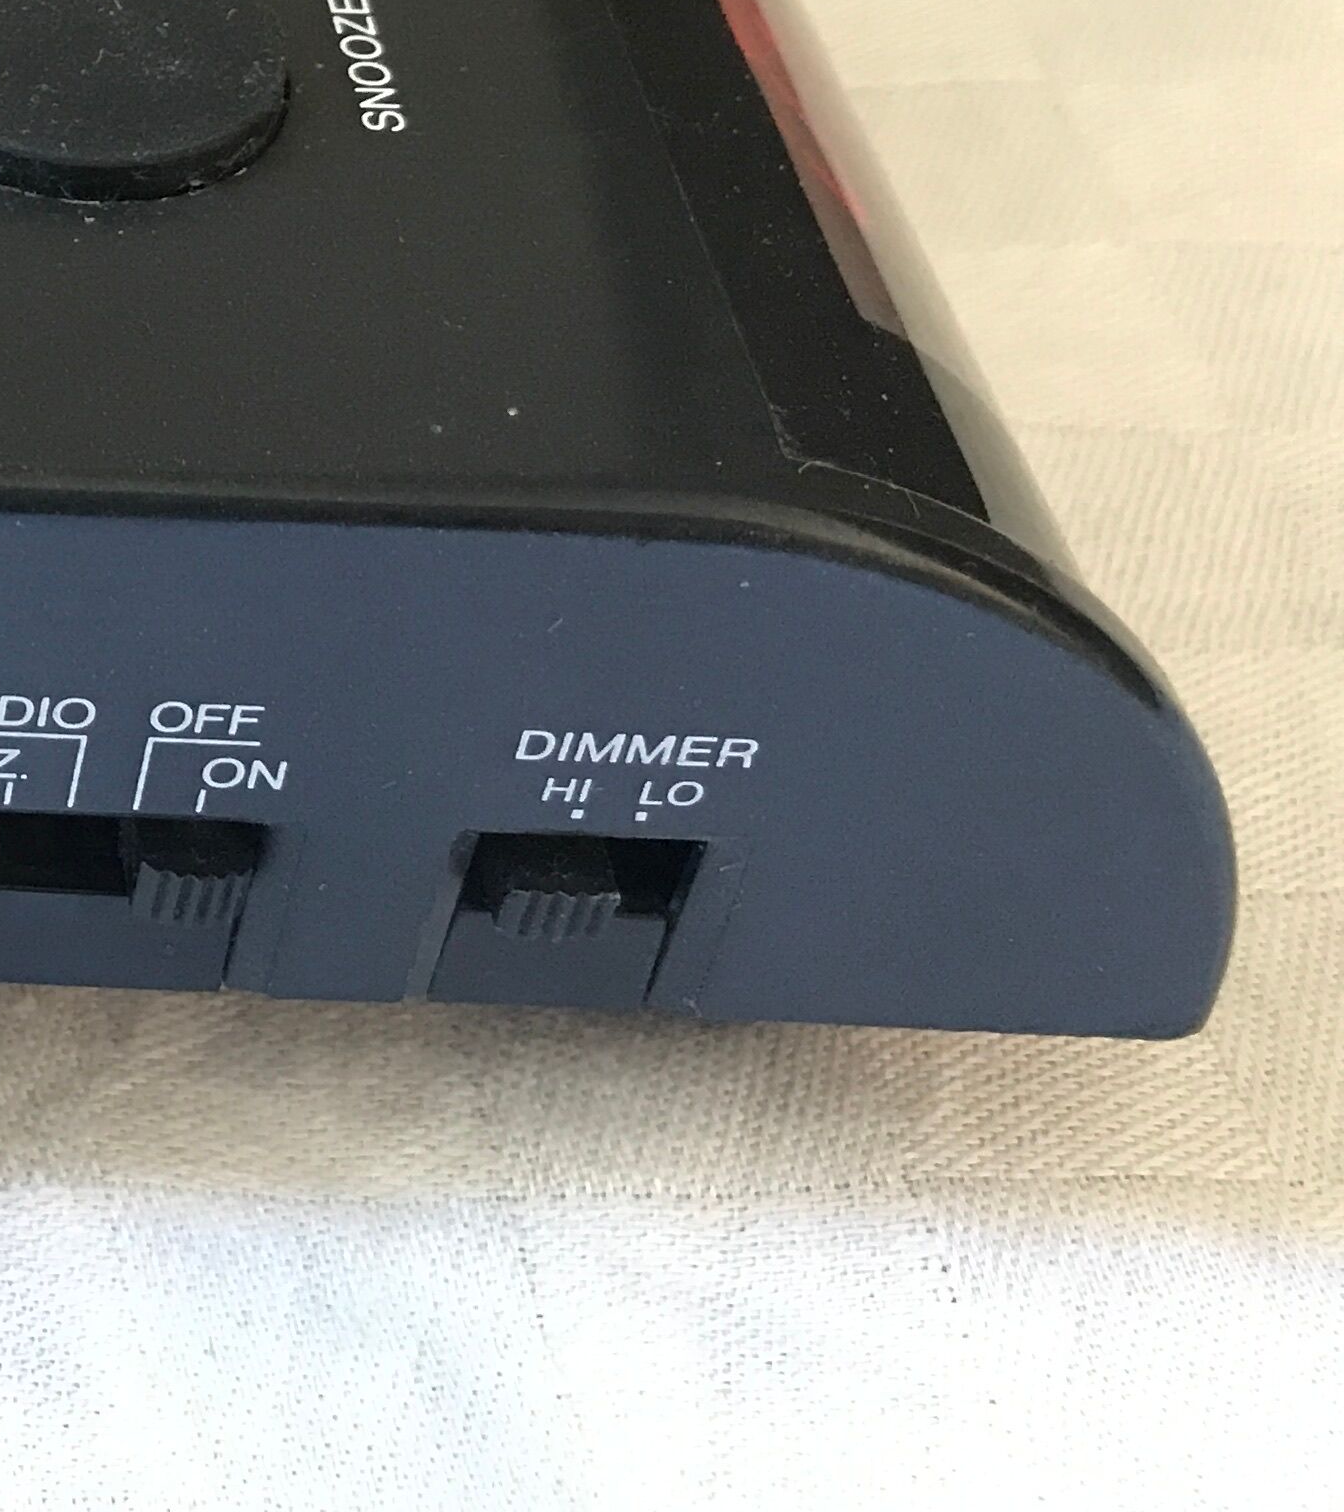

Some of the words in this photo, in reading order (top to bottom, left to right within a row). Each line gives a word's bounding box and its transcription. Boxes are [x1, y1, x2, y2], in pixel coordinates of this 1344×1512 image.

[149, 700, 266, 736] OFF
[515, 729, 760, 769] DIMMER
[201, 756, 288, 791] ON
[541, 777, 593, 803] HI
[638, 780, 705, 807] LO
